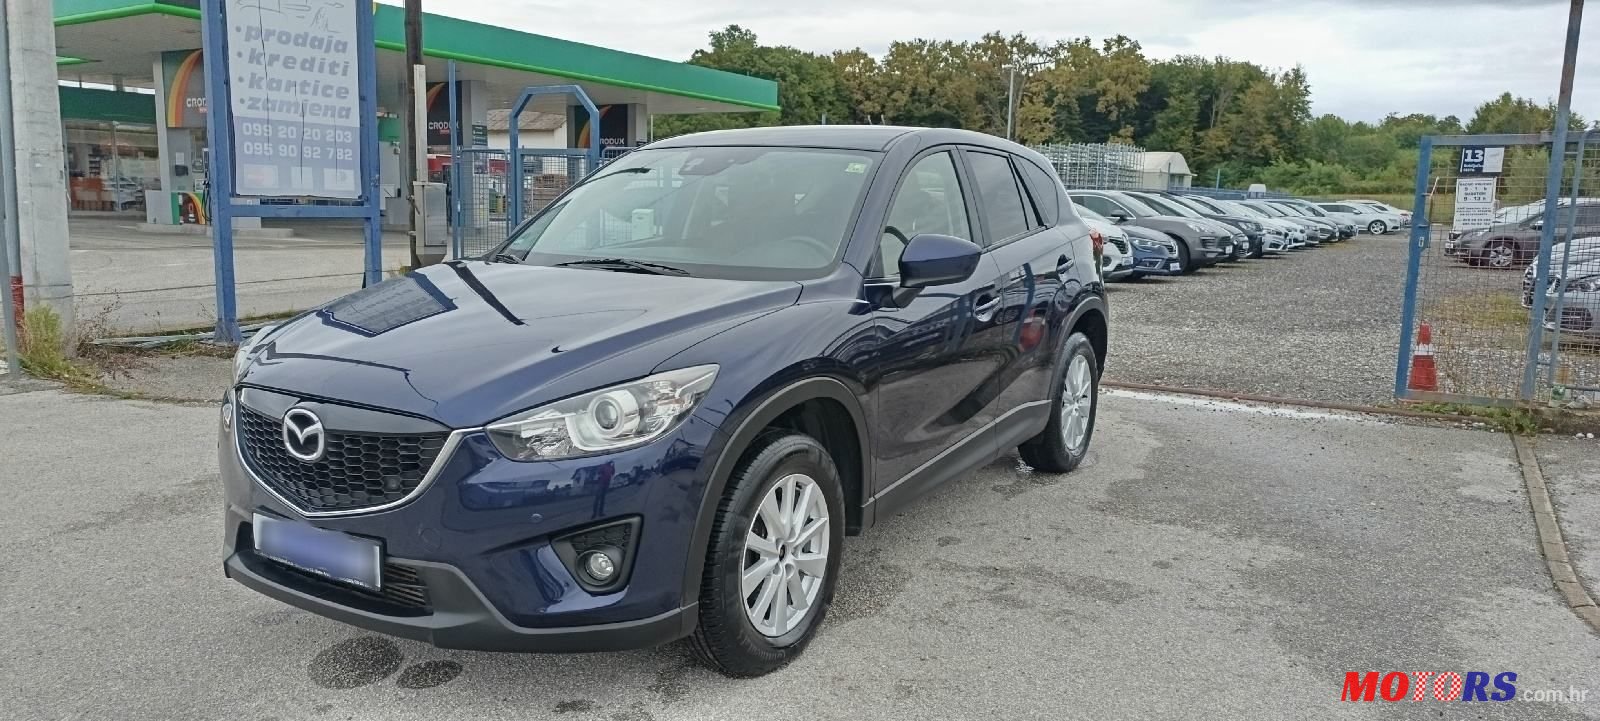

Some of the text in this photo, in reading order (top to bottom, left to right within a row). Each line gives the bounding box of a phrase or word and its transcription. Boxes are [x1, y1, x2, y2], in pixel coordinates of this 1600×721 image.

[244, 25, 349, 54] prodaja
[248, 48, 351, 77] krediti
[247, 72, 350, 100] kartice
[247, 96, 352, 120] zamjena
[242, 122, 352, 143] 099 20 20 203
[243, 141, 353, 161] 095 90 92 782
[1464, 149, 1484, 163] 13
